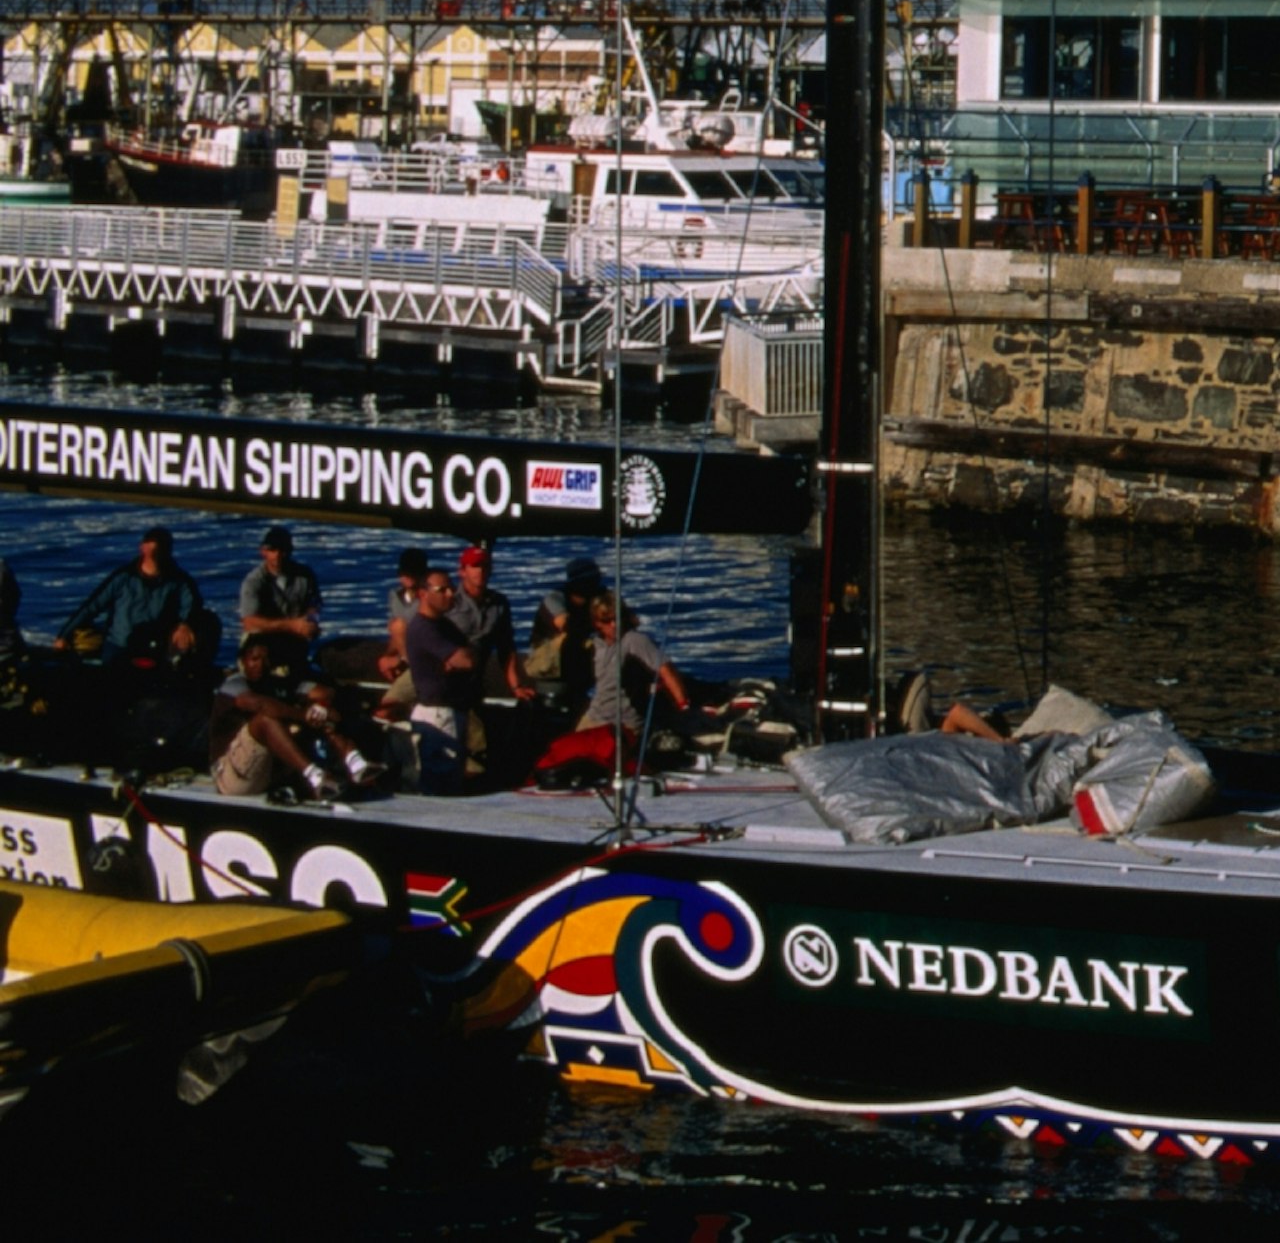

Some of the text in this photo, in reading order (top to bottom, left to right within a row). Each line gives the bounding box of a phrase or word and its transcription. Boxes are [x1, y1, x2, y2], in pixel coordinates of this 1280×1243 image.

[244, 437, 434, 509] SHIPPING
[443, 453, 522, 518] CO.
[853, 938, 1194, 1016] NEDBANK
